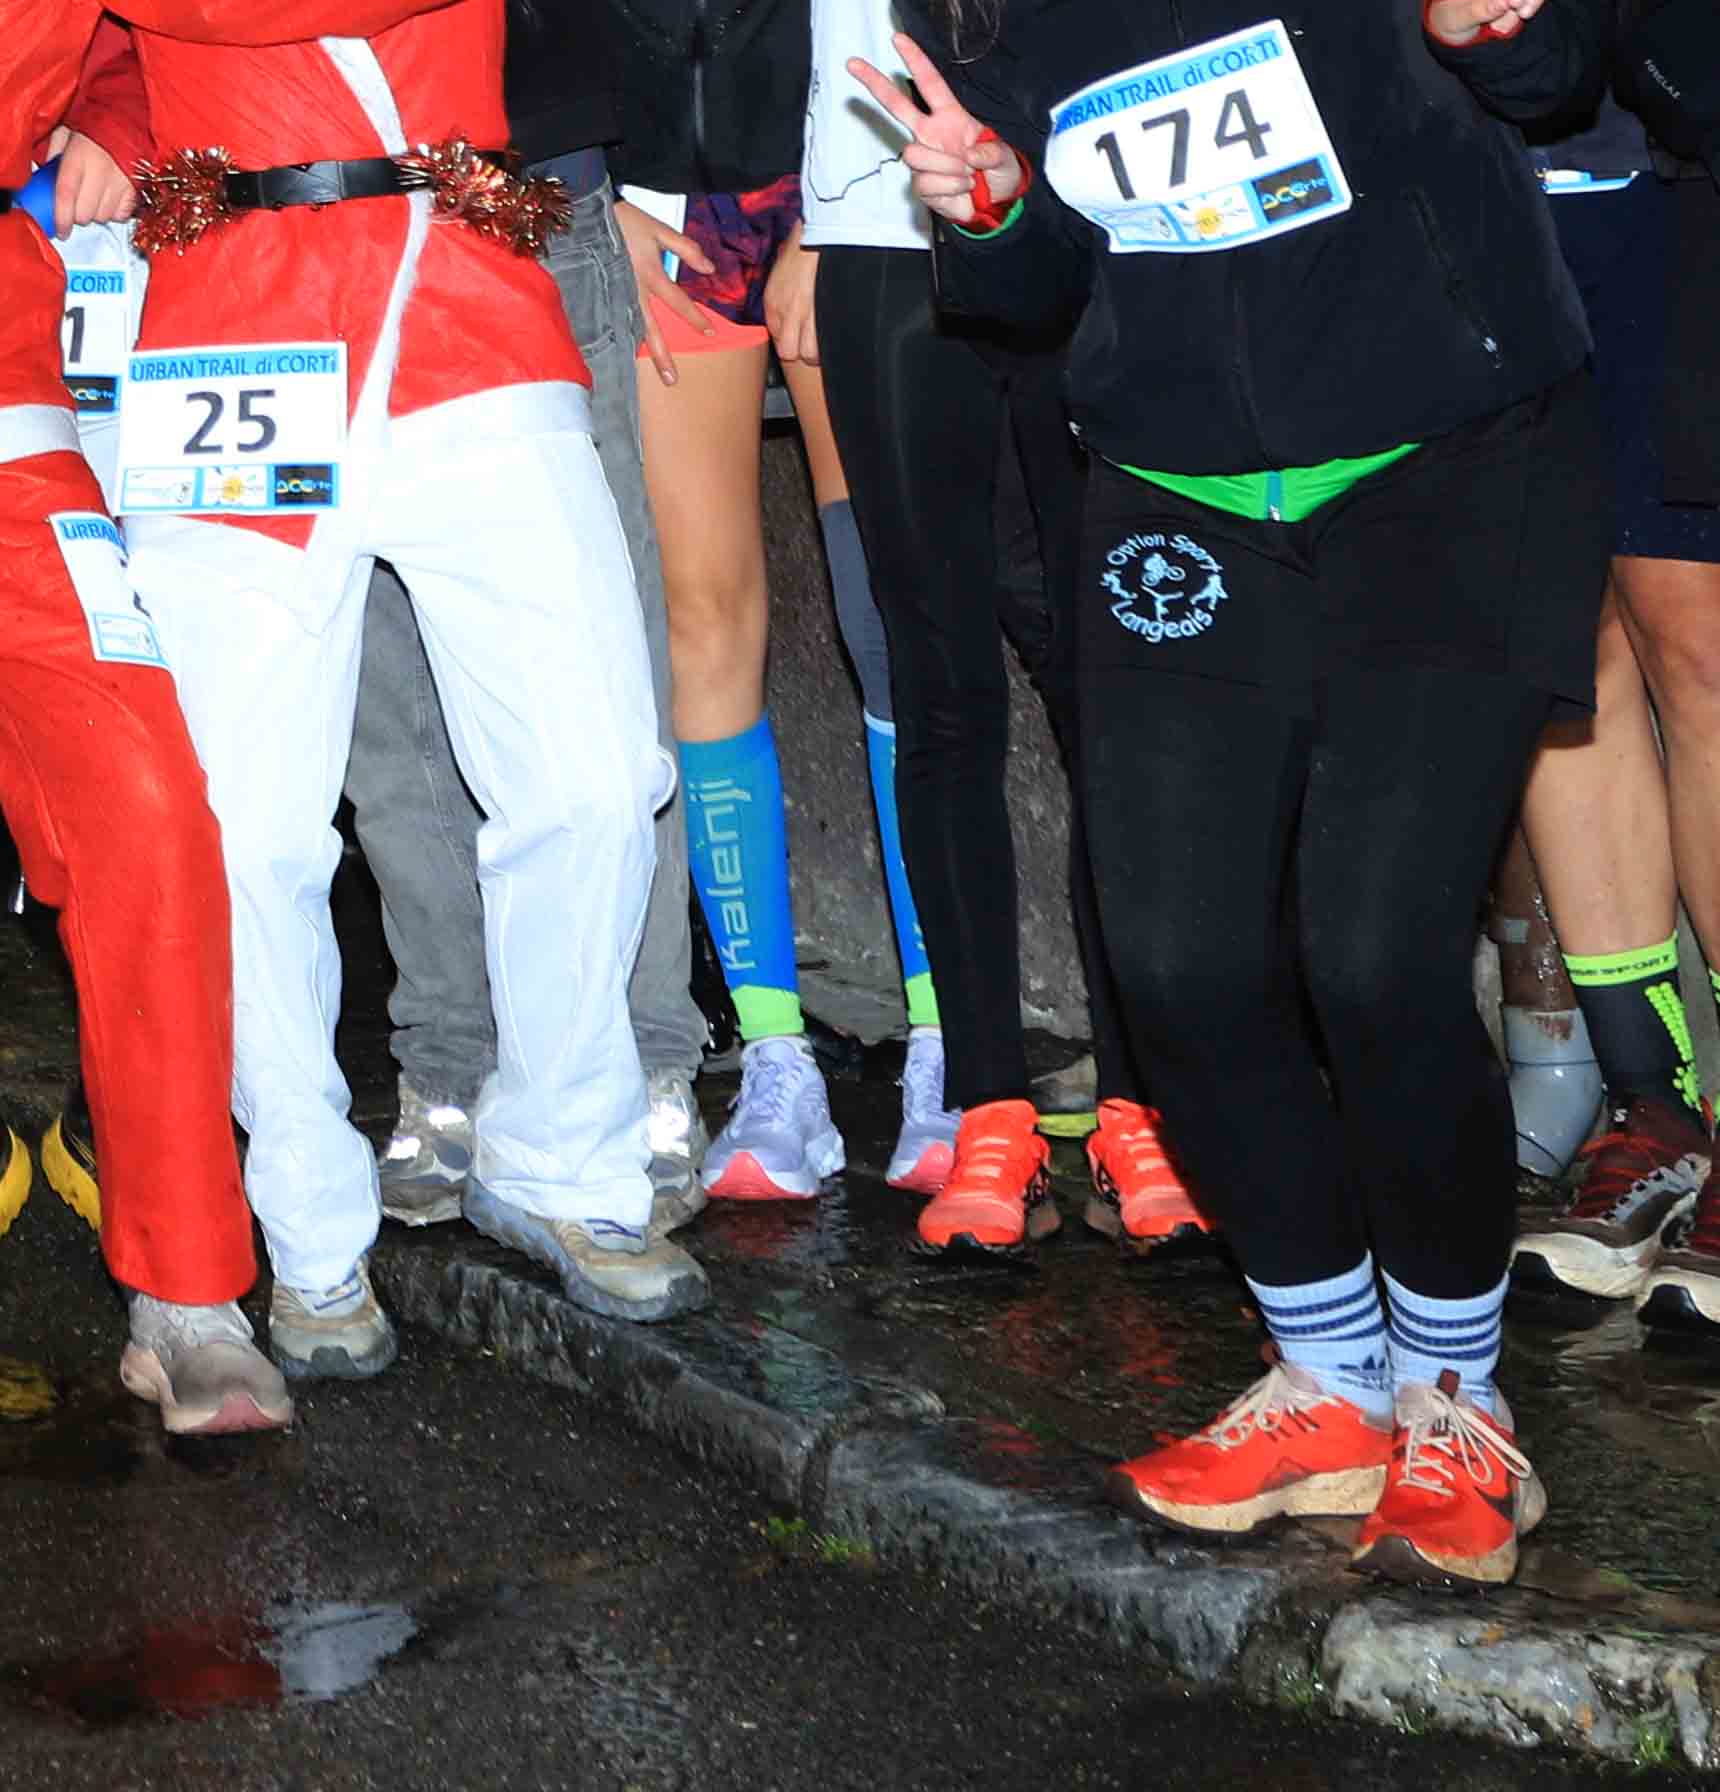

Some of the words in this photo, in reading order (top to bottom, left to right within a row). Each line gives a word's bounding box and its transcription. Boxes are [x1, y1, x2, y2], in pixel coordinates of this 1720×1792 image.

[1116, 75, 1179, 108] TRAIL
[1183, 64, 1203, 88] di
[1094, 88, 1273, 201] 174
[131, 361, 194, 381] URBAN
[198, 358, 249, 377] TRAIL
[256, 356, 272, 374] di
[183, 389, 278, 455] 25
